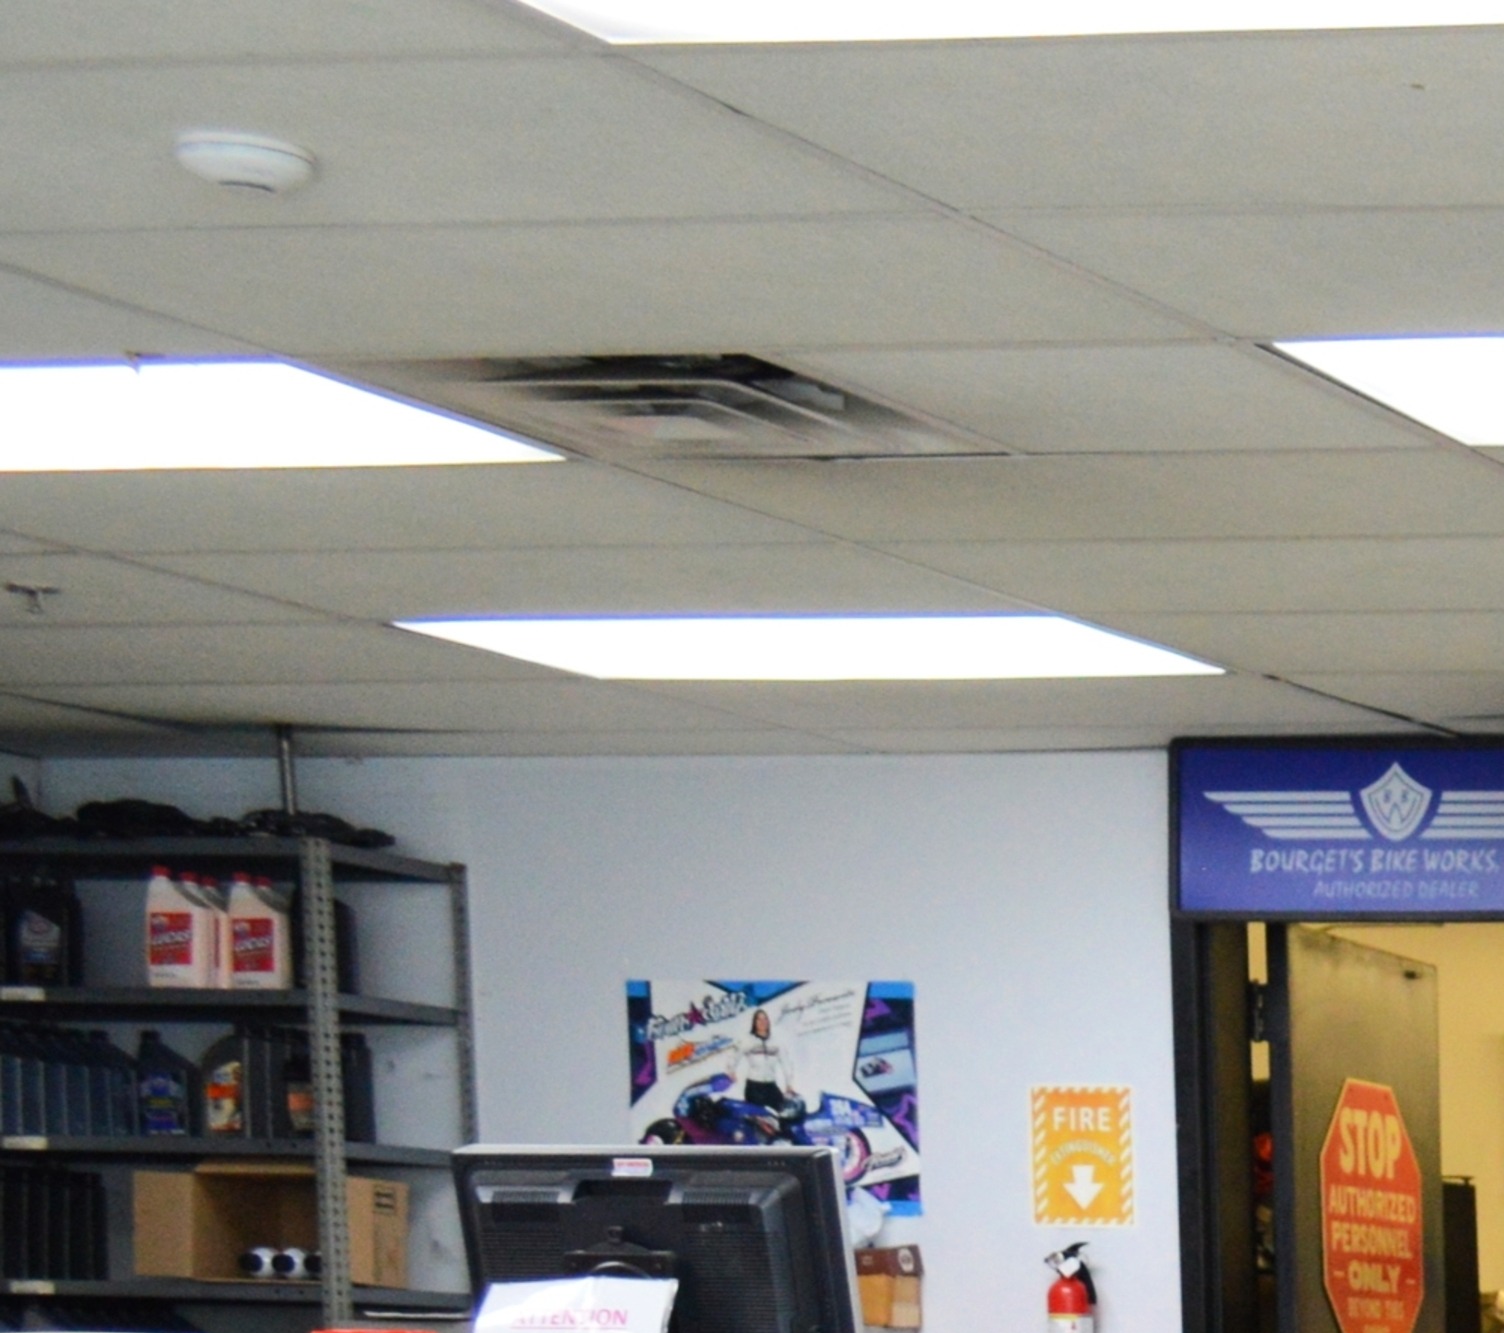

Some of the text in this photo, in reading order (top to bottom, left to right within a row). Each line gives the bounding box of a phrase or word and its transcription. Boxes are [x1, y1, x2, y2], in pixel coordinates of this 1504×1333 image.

[1250, 848, 1364, 874] BOURGET'S
[1369, 849, 1417, 873] BIKE
[1313, 880, 1479, 898] AUTHORIZED DEALER
[1052, 1105, 1112, 1132] FIRE
[1338, 1106, 1402, 1180] STOP
[1329, 1183, 1417, 1225] AUTHORIZED
[1331, 1219, 1414, 1260] PERSONNEL
[1347, 1259, 1400, 1295] ONLY
